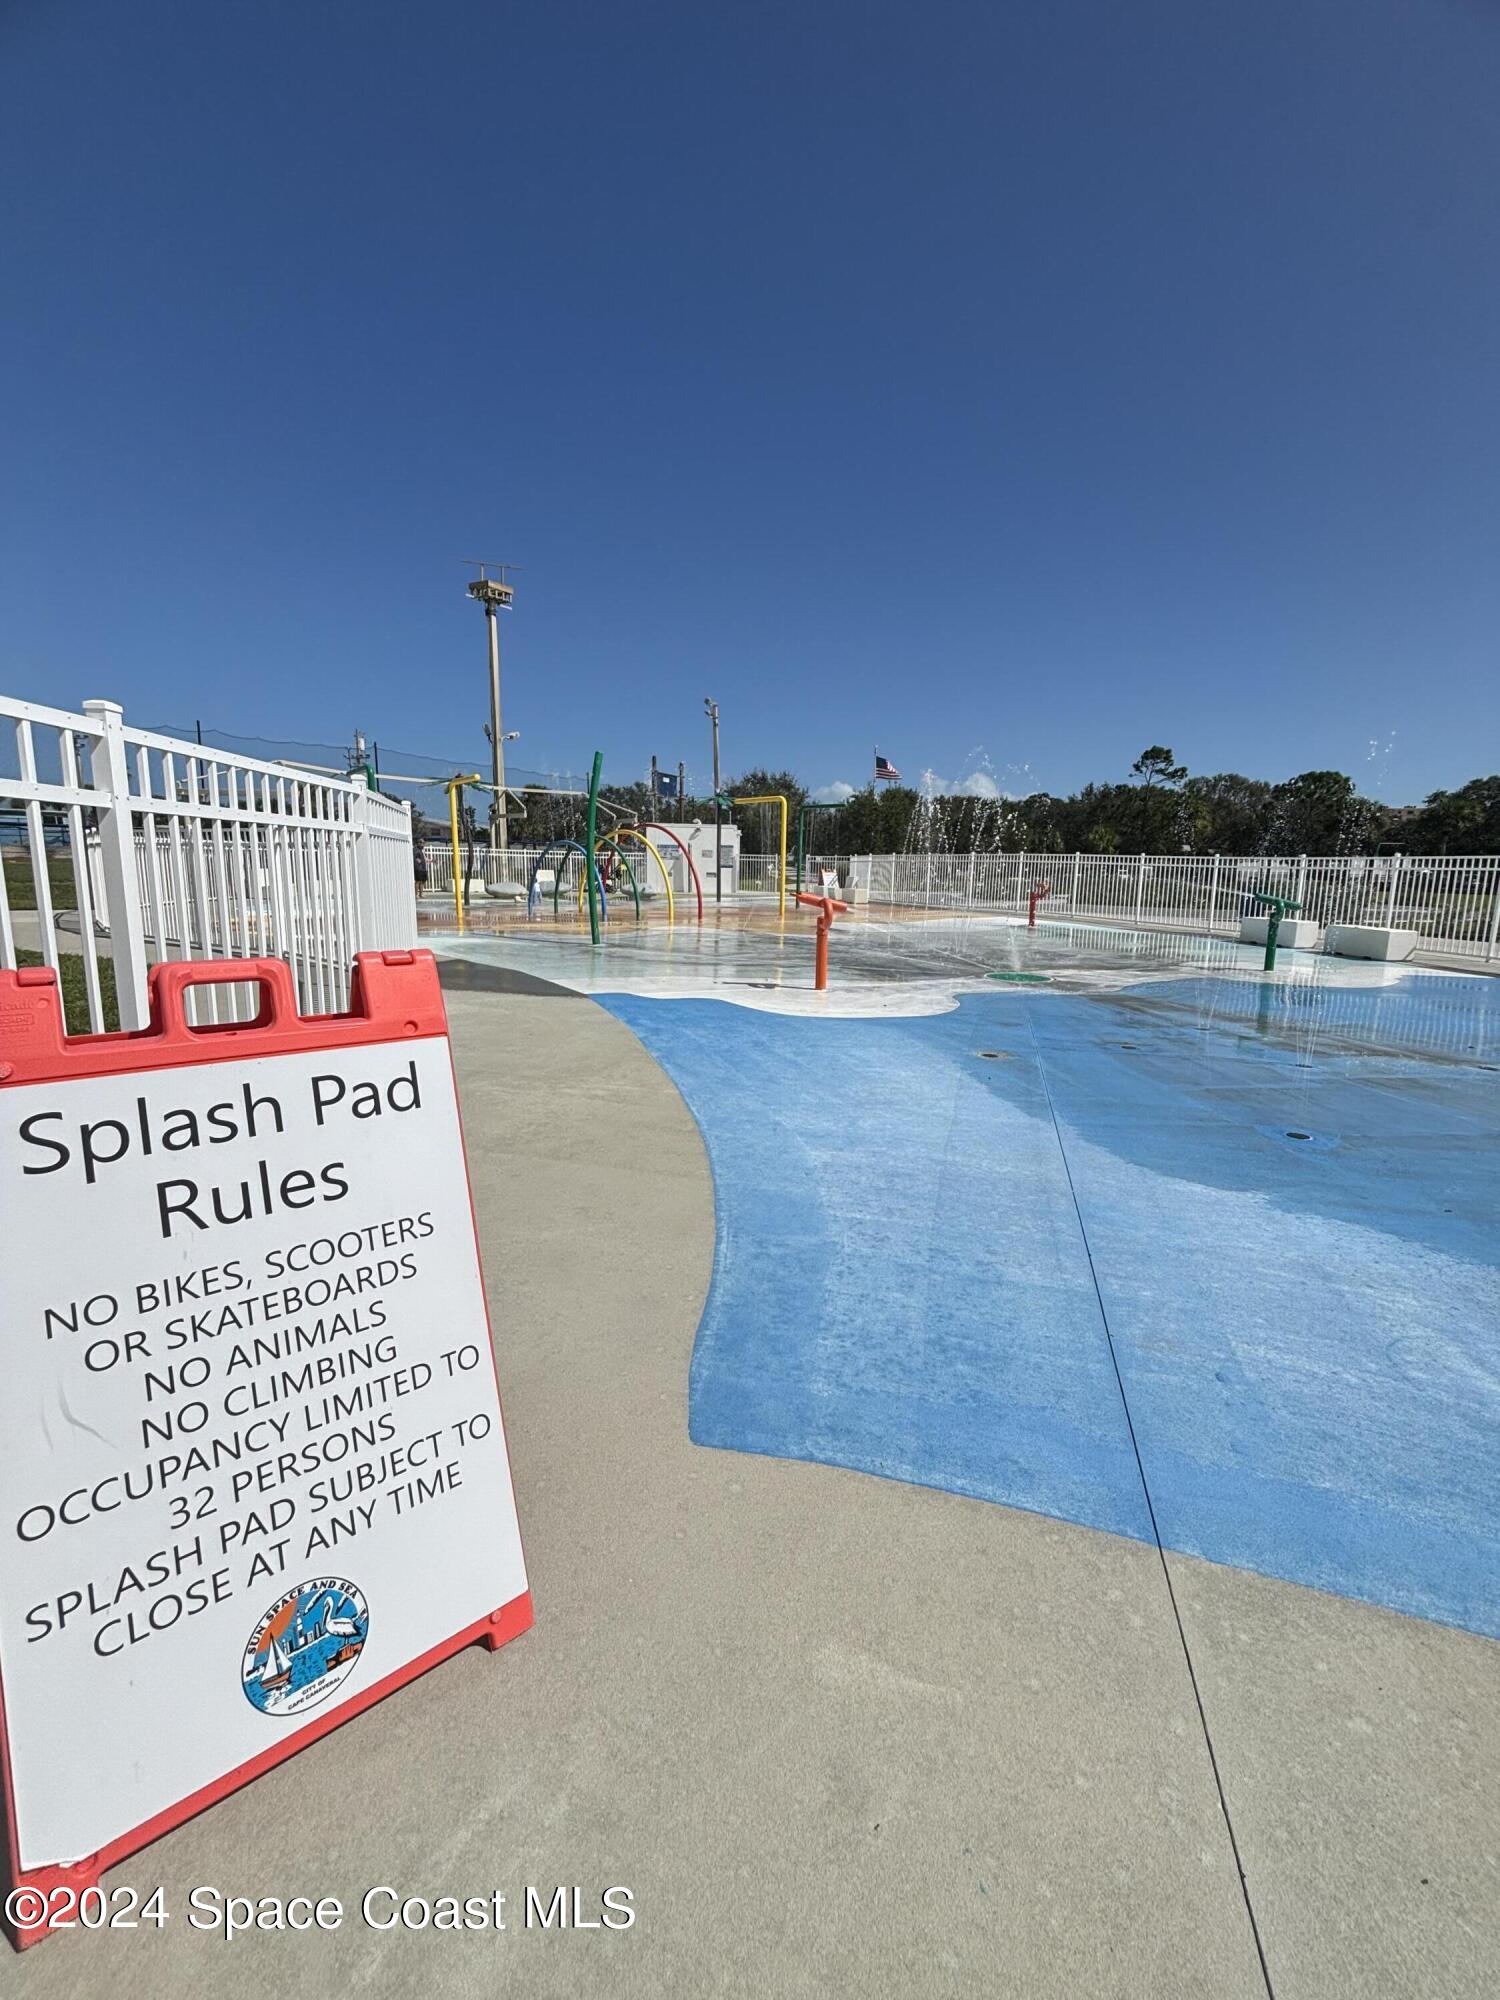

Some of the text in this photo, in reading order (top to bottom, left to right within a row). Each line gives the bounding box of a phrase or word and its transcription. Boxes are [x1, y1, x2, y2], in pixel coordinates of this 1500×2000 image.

[20, 1061, 421, 1184] Splash Pad
[157, 1160, 349, 1238] Rules
[45, 1212, 434, 1339] NO BIKES, SCOOTERS
[85, 1254, 417, 1371] OR SKATEBOARDS
[142, 1336, 397, 1448] NO CLIMBING
[145, 1301, 387, 1401] NO ANIMALS
[16, 1346, 479, 1542] OCCUPANCY LIMITED TO
[169, 1413, 396, 1529] 32 PERSONS
[26, 1414, 491, 1642] SPLASH PAD SUBJECT TO
[93, 1462, 462, 1656] CLOSE AT ANY TIME
[247, 1580, 358, 1655] SUN SPACE AND SEA
[302, 1678, 327, 1695] CITY OF
